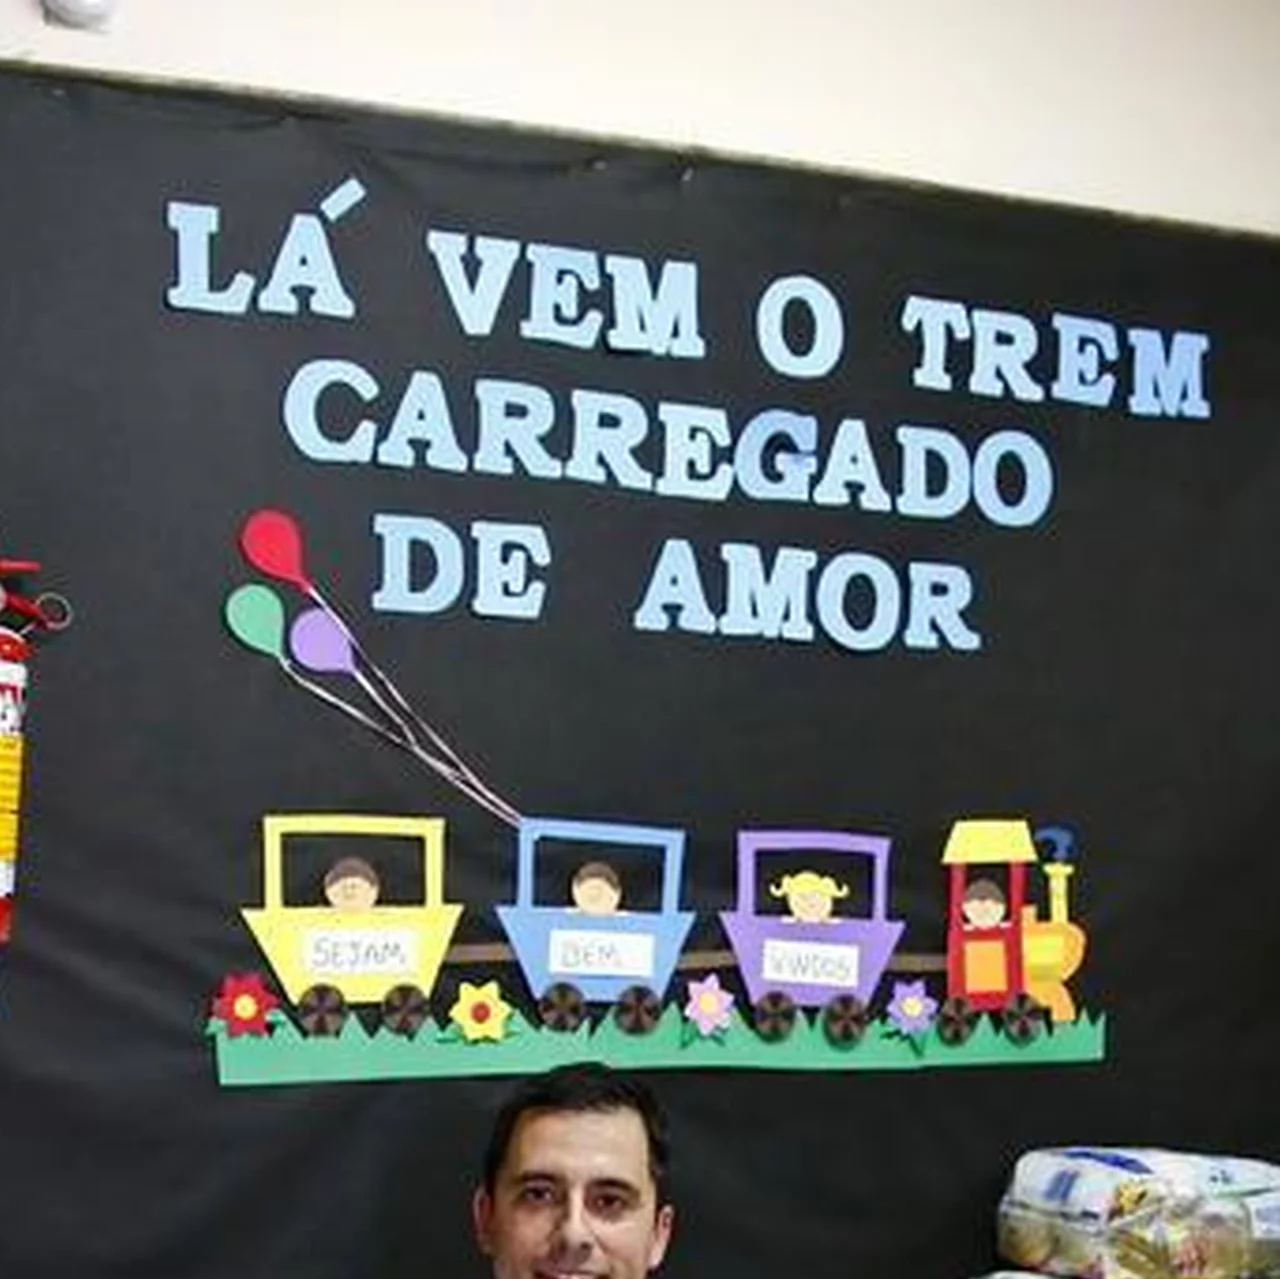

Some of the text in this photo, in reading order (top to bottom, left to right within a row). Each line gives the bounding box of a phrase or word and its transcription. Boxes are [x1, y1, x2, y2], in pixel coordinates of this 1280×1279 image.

[167, 177, 1211, 418] LÁ VEM O TREM
[283, 359, 1054, 527] CARREGADO
[372, 514, 981, 652] DE AMOR
[312, 936, 407, 967] SEJAM
